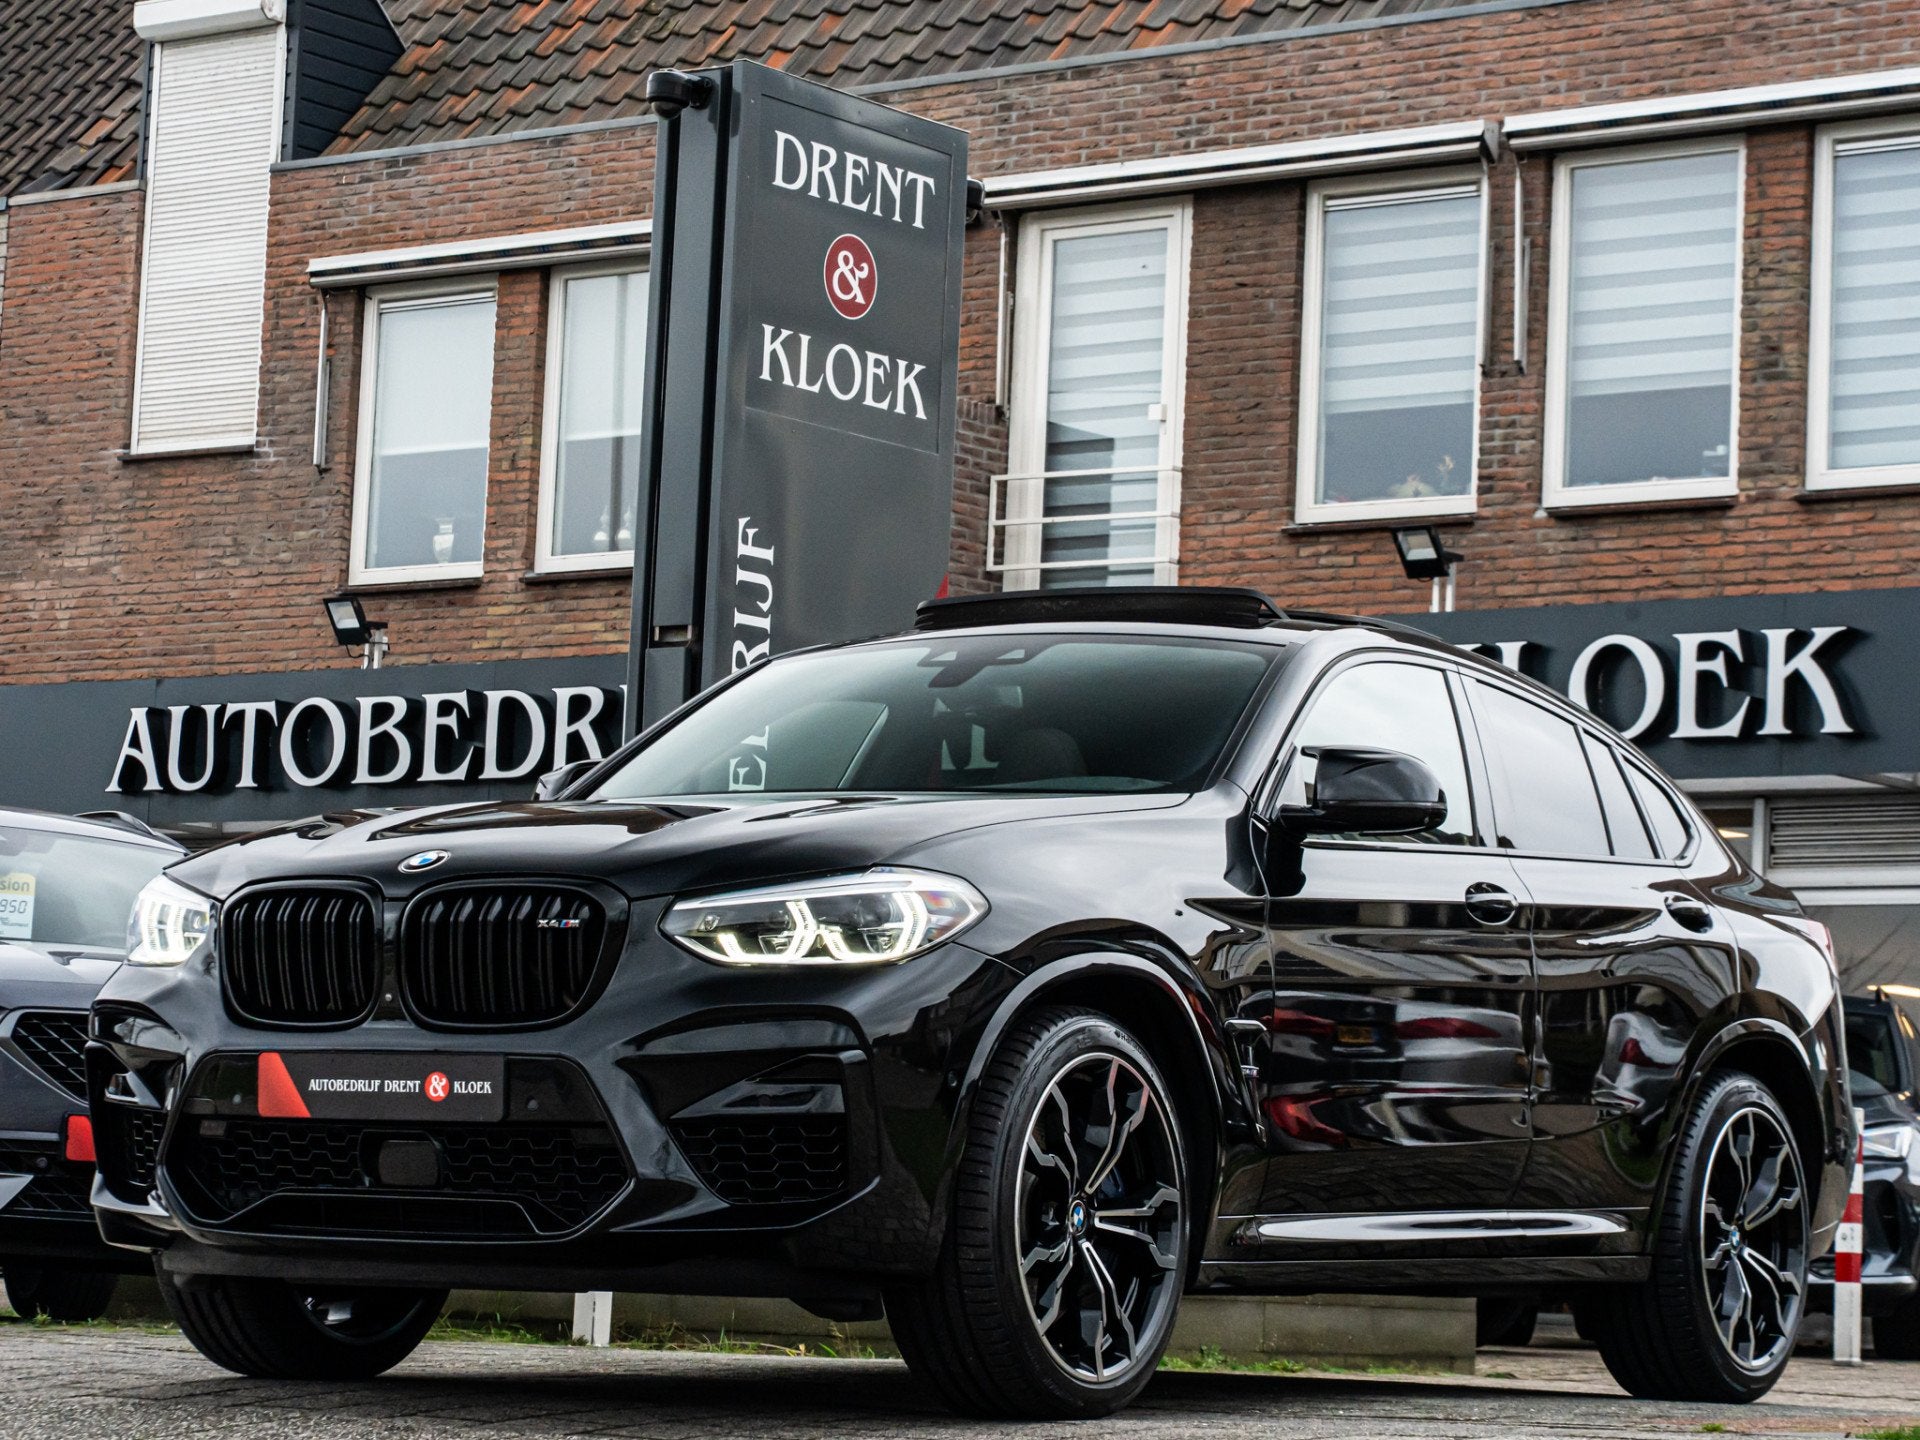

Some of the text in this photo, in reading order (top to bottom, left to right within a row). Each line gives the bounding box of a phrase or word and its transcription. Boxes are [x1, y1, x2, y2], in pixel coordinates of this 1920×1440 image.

[772, 130, 935, 229] DRENT
[832, 250, 869, 305] &
[759, 323, 927, 420] KLOEK
[1454, 626, 1854, 741] OEK
[308, 1074, 492, 1097] AUTOBEDRIJF DRENT & KLOEK
